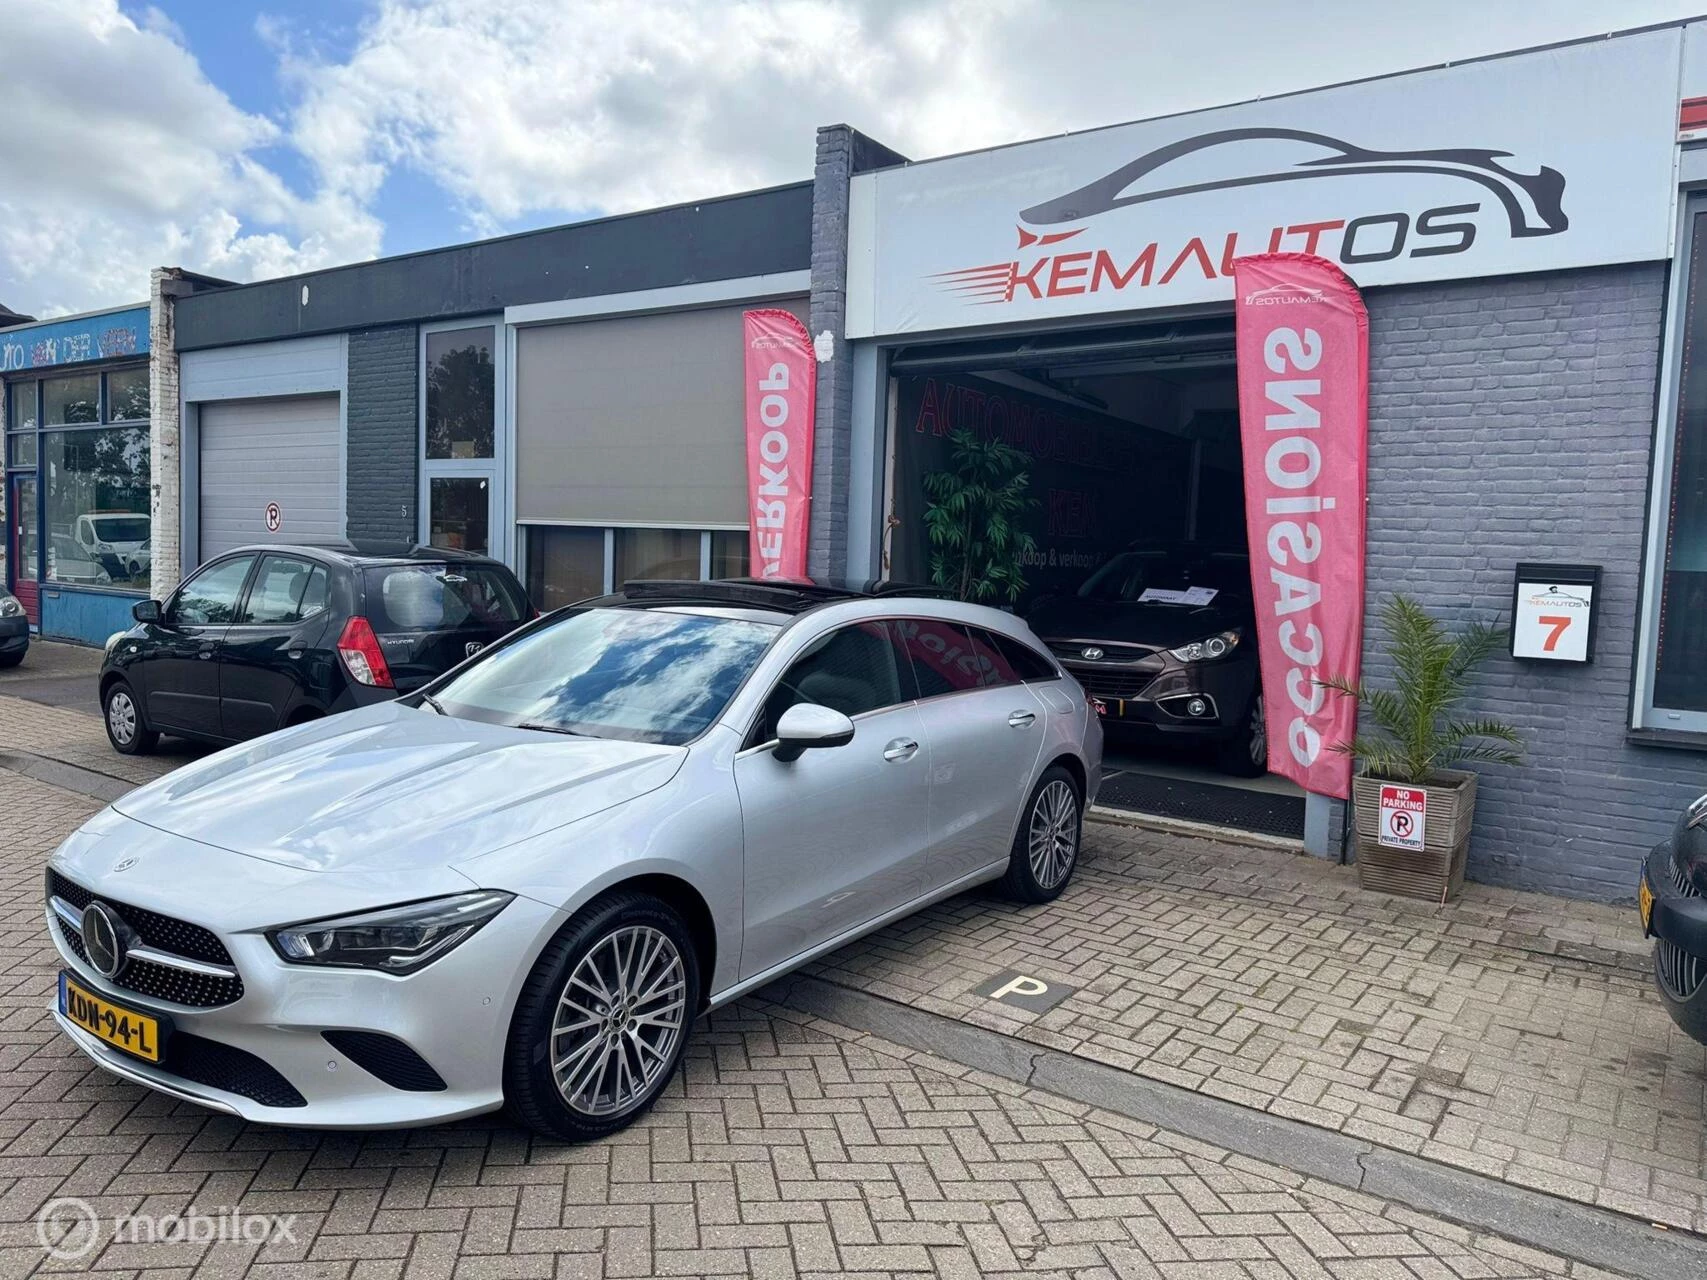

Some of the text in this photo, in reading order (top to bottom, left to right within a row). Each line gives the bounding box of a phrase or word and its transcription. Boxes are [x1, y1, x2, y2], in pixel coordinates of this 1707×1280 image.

[1007, 202, 1479, 302] KEMAUTOS
[1538, 616, 1572, 652] 7
[1383, 797, 1423, 811] PARKING
[1396, 790, 1410, 800] NO
[67, 987, 152, 1054] KDN-94-L
